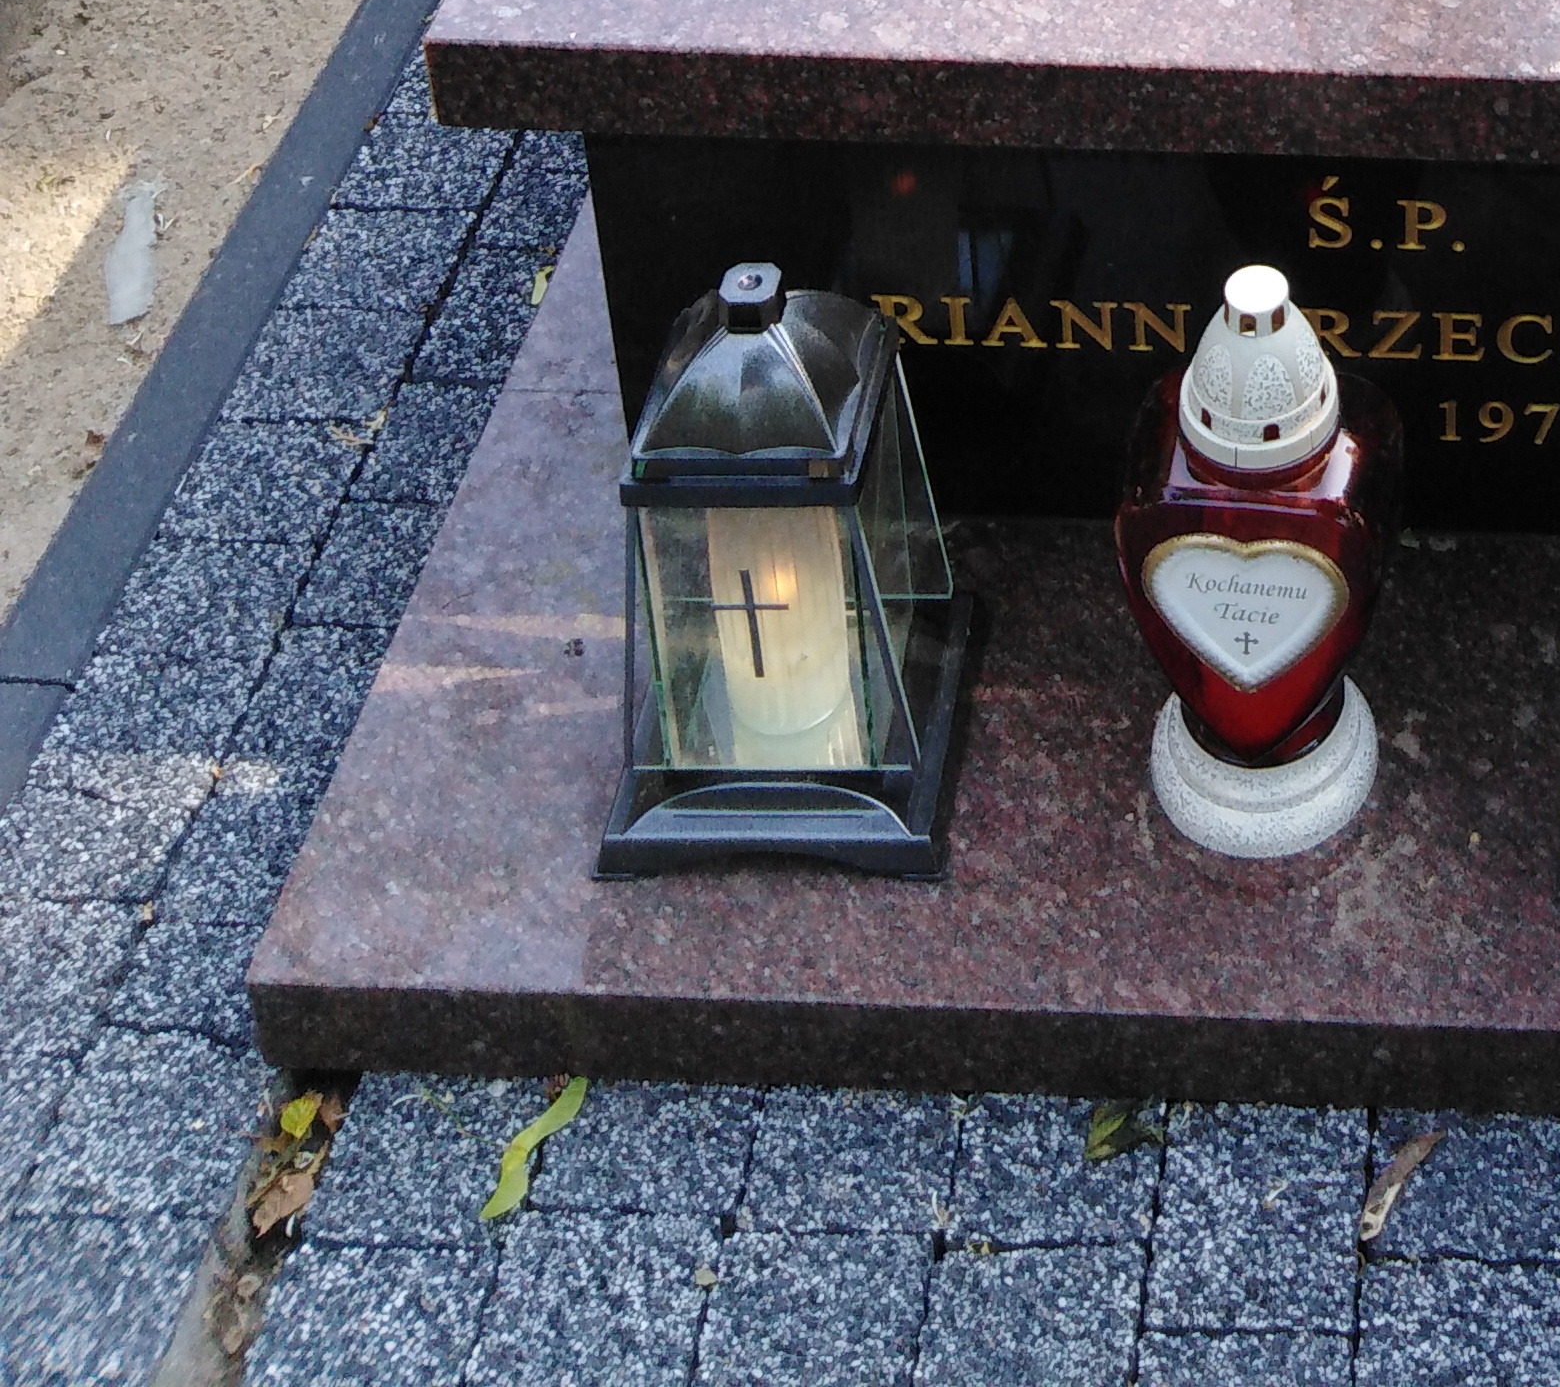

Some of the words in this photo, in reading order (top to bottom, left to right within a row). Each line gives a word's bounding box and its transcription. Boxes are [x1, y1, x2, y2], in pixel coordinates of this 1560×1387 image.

[1308, 176, 1465, 252] Ś.P.
[870, 294, 1191, 352] RIANN
[1185, 571, 1309, 601] Kochanemu
[1213, 602, 1280, 625] Tacie
